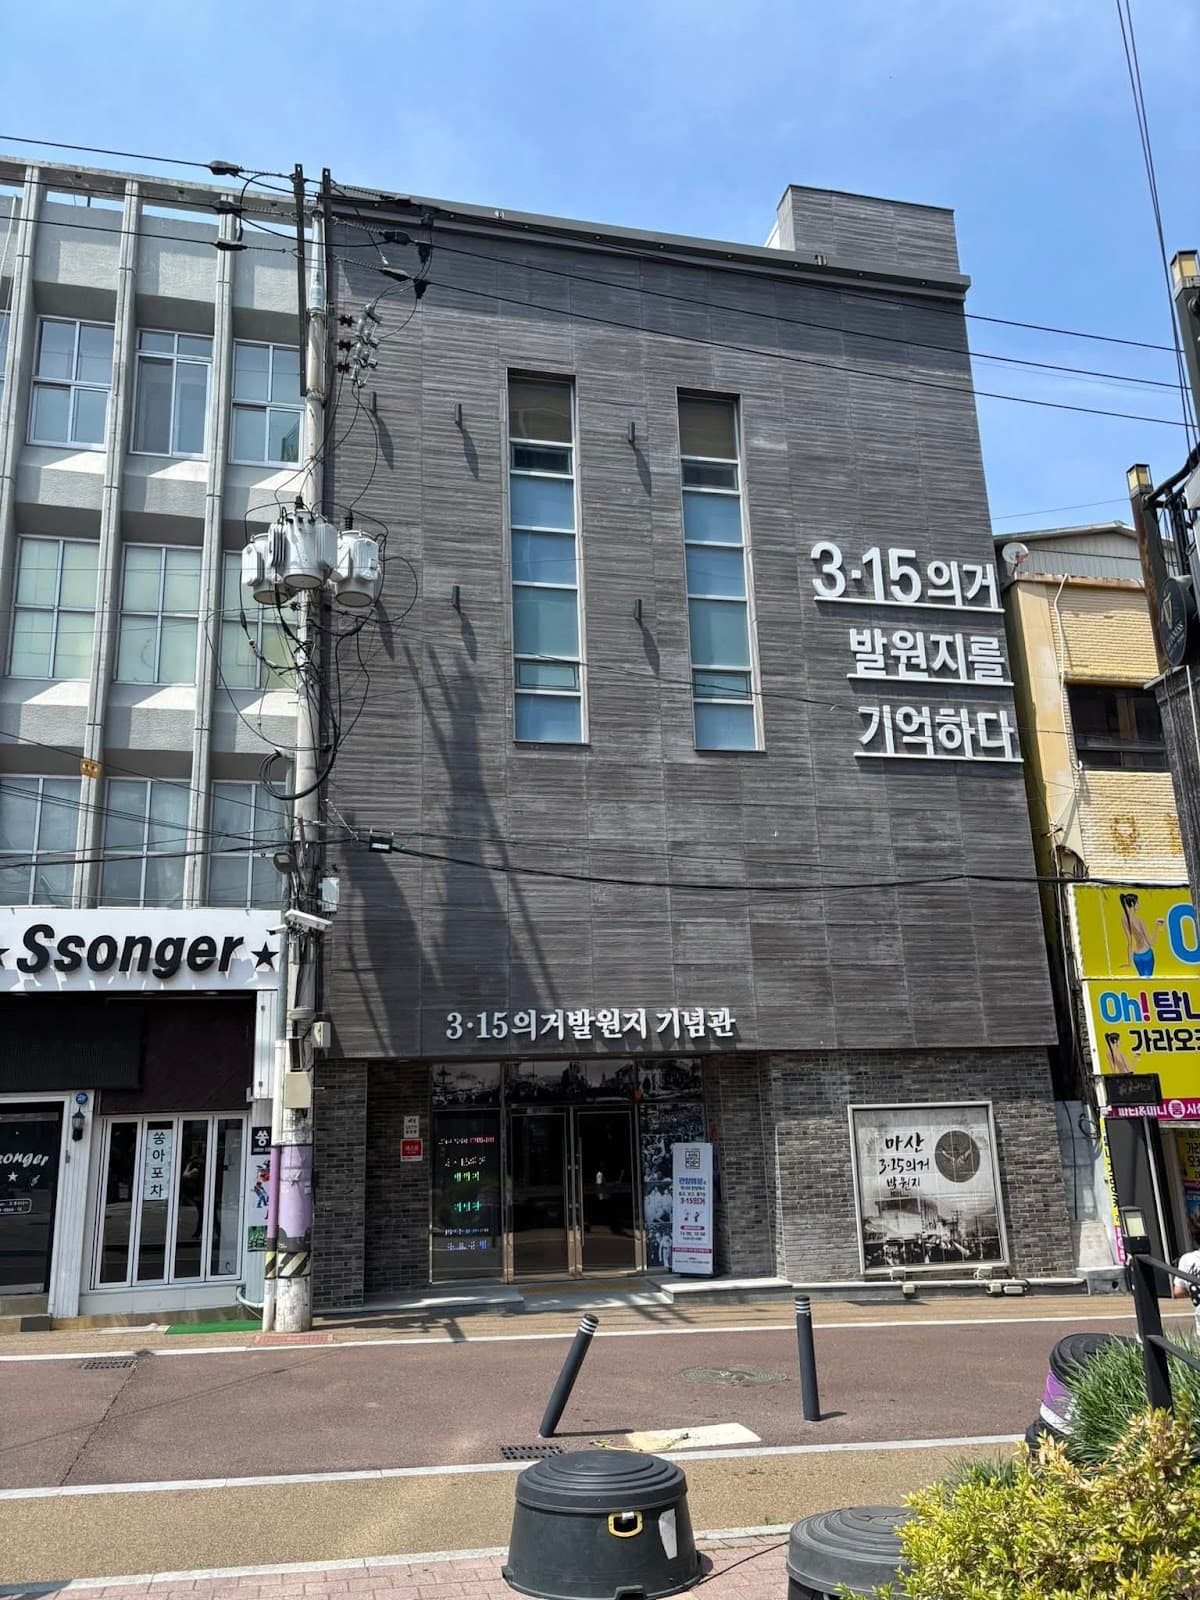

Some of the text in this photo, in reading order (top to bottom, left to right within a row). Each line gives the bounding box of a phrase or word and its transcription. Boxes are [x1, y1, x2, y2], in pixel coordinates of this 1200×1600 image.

[810, 541, 999, 609] 3·15의거
[850, 628, 1005, 683] 발원지를
[857, 704, 1015, 760] 기억하다
[16, 924, 245, 979] Ssonger
[656, 1008, 736, 1040] 기념관
[1100, 991, 1151, 1022] Oh!
[149, 1131, 166, 1198] 쏭아포차
[885, 1132, 925, 1153] 마산
